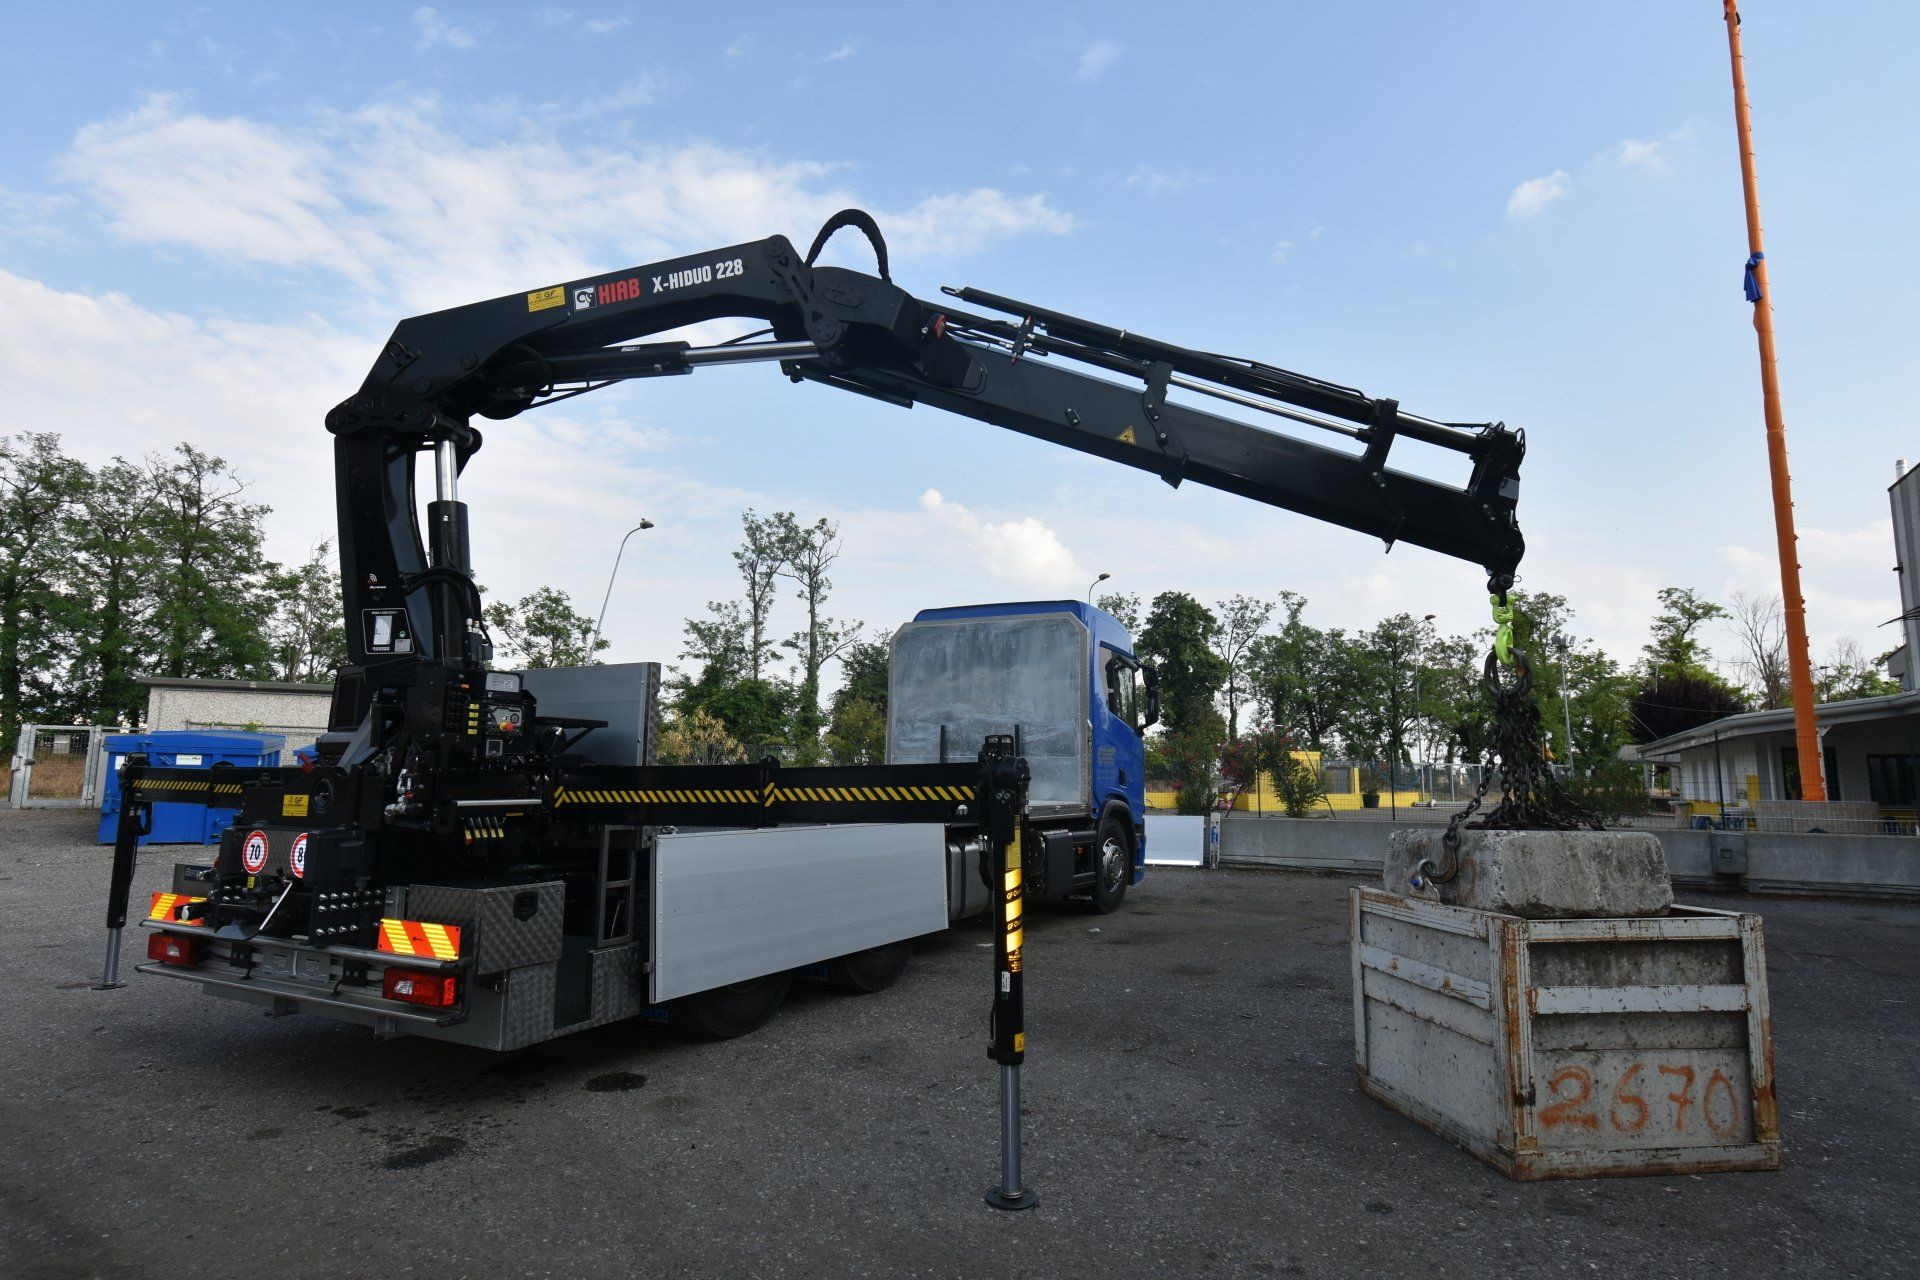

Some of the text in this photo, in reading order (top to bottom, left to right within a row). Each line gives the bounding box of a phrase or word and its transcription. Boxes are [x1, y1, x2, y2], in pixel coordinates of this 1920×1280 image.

[598, 258, 744, 305] HIAB X-HIDUO 228
[249, 844, 261, 861] 70
[1537, 1062, 1740, 1139] 2670
